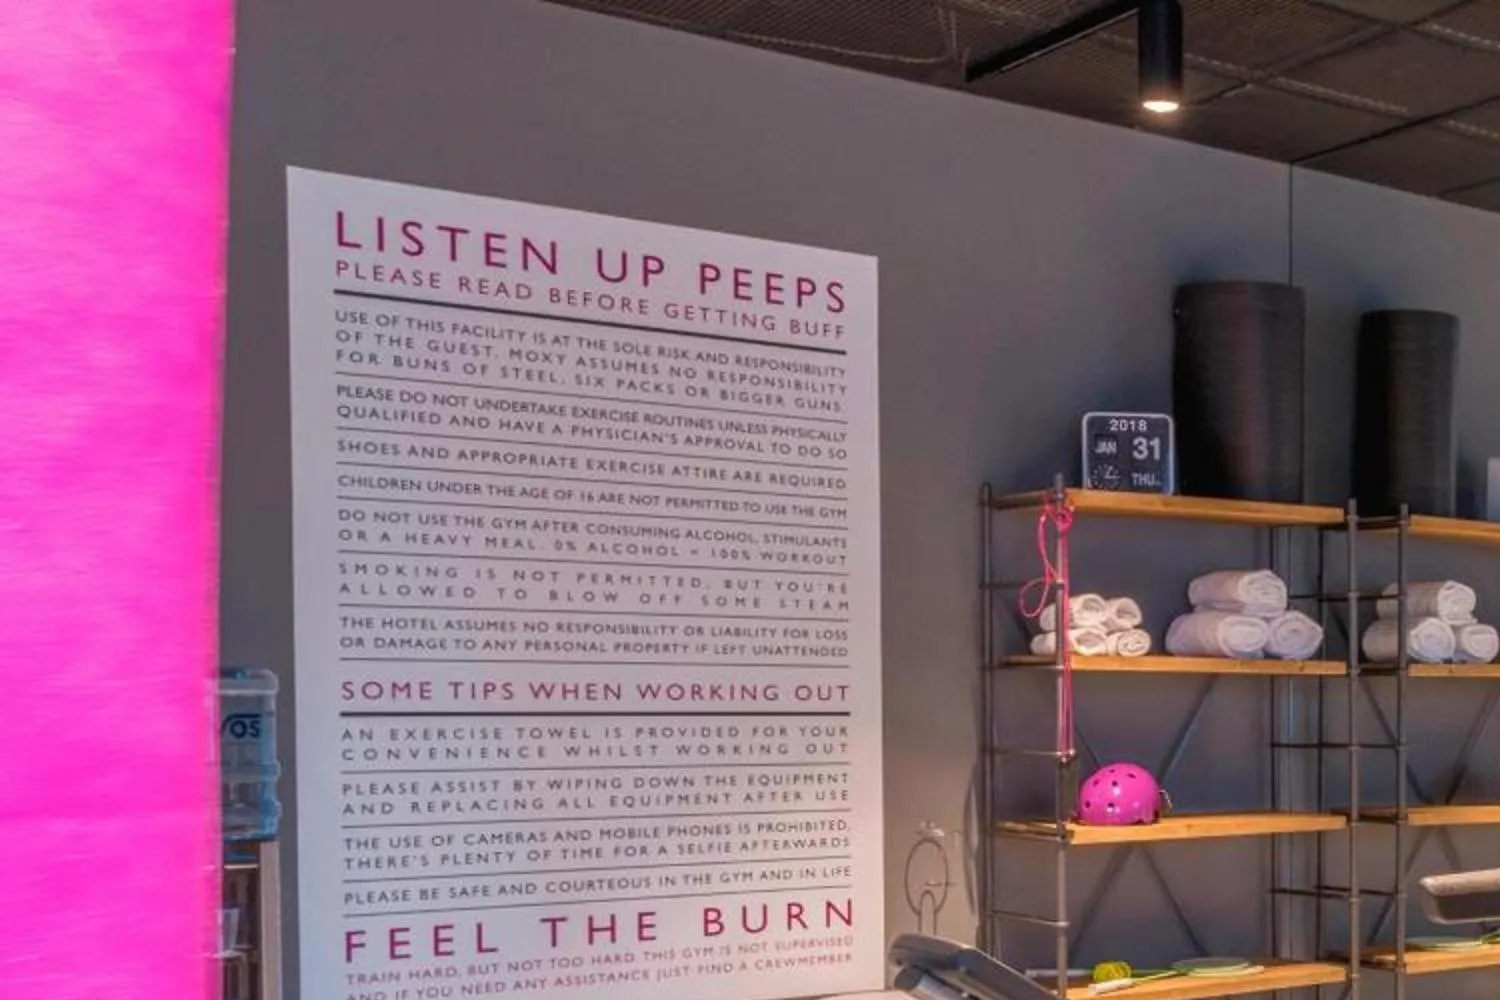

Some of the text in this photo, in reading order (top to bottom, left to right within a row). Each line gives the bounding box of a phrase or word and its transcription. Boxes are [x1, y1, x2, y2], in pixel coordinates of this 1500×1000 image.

[335, 209, 845, 314] LISTEN UP PEEPS
[335, 259, 844, 339] PLEASE READ BEFORE GETTING BUFF
[334, 308, 729, 365] USE OF THIS FACILITY IS AT THE SOLE RISK AND
[334, 329, 697, 379] OF THE MOXY ASSUMES NO
[335, 349, 784, 406] FOR BUNS OF SIX PACKS OR BIGGER
[335, 383, 768, 435] PLEASE DO NOT UNDERTAKE EXERCISE ROUTINES UNLESS
[335, 404, 764, 452] QUALIFIED AND HAVE A APPROVAL
[1108, 419, 1148, 432] 2018
[336, 439, 761, 483] SHOES AND APPROPRIATE EXERCISE ATTIRE ARE
[1132, 436, 1161, 460] 31
[336, 473, 660, 507] CHILDREN UNDER THE AGE OF ARE NOT
[337, 508, 681, 539] DO NOT USE THE GYM AFTER CONSUMING
[337, 528, 471, 547] OR A HEAVY
[339, 616, 678, 636] THE HOTEL ASSUMES NO RESPONSIBILITY
[338, 635, 689, 654] OR DAMAGE TO ANY PERSONAL PROPERTY
[341, 680, 849, 701] SOME TIPS WHEN WORKING OUT
[340, 725, 788, 741] AN EXERCISE TOWEL IS PROVIDED FOR
[340, 743, 789, 761] CONVENIENCE WHILST WORKING
[341, 772, 848, 796] PLEASE ASSIST BY WIPING DOWN THE EQUIPMENT
[342, 790, 802, 816] AND REPLACING ALL EQUIPMENT AFTER
[343, 822, 751, 851] THE USE OF CAMERAS AND MOBILE PHONES IS
[343, 841, 731, 870] THERE'S PLENTY OF TIME FOR A SELFIE
[343, 868, 793, 905] PLEASE BE SAFE AND COURTEOUS IN THE GYM AND
[344, 897, 853, 964] FEEL THE BURN
